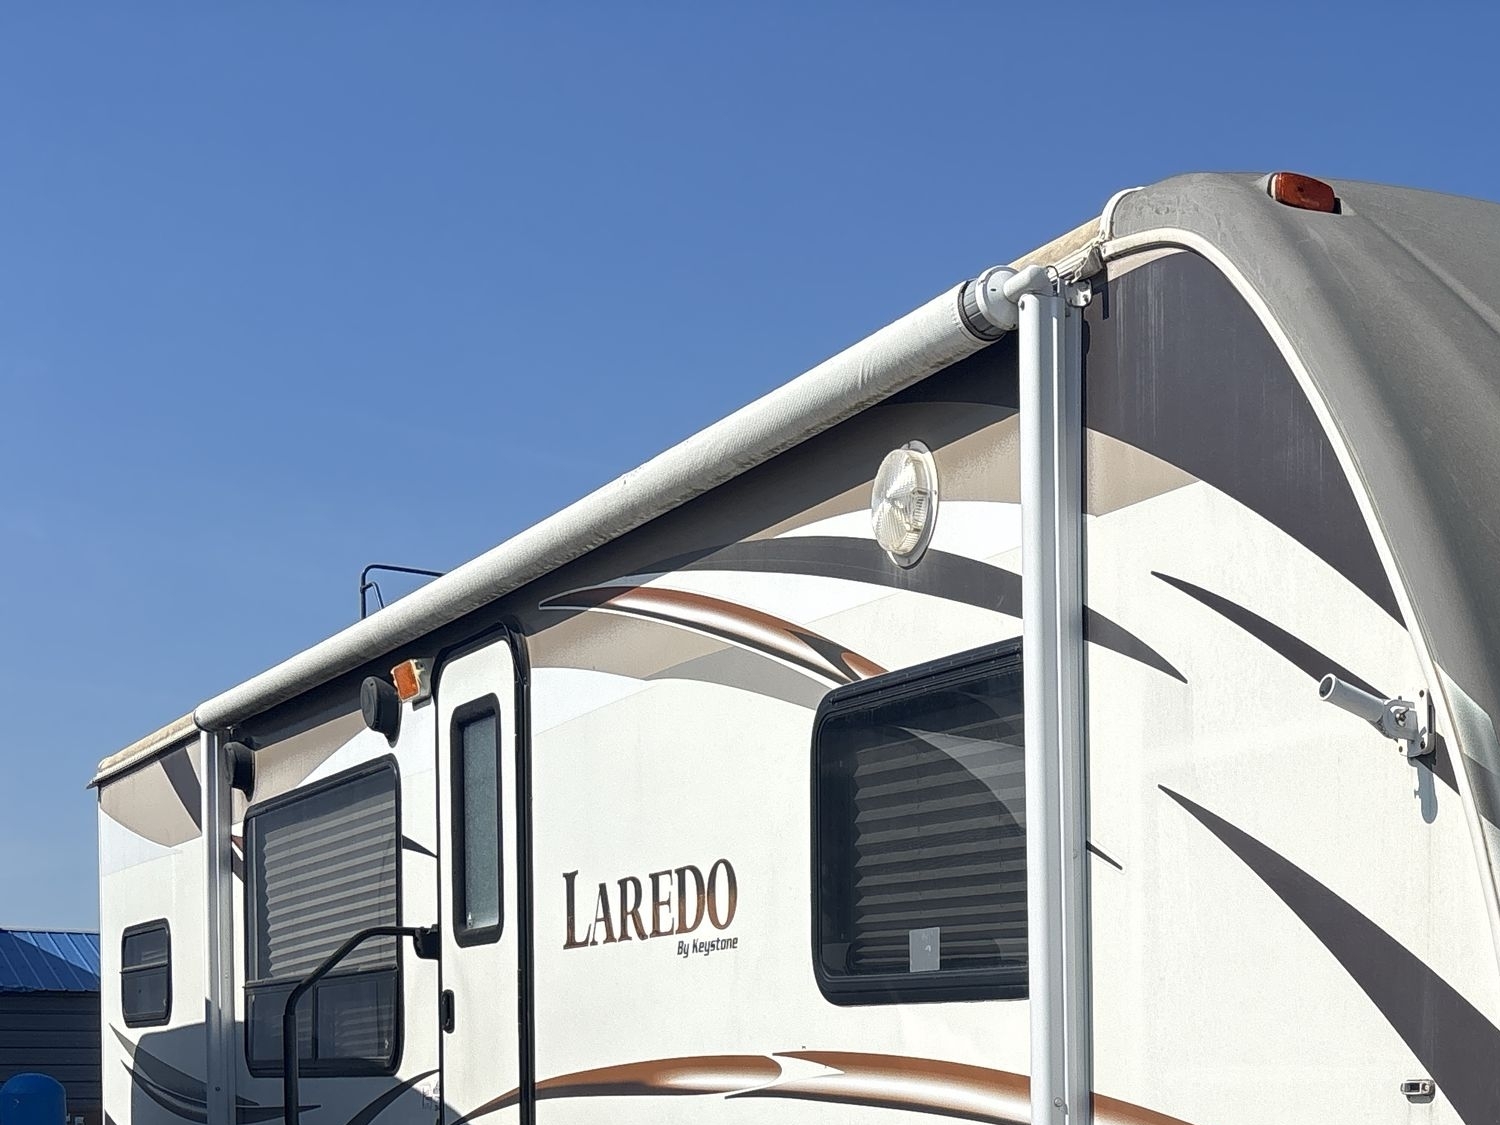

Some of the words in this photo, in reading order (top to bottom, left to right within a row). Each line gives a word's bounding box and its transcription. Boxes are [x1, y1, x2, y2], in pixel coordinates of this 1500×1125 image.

[562, 858, 738, 950] LAREDO
[677, 940, 689, 958] By
[692, 937, 738, 958] Keystone
